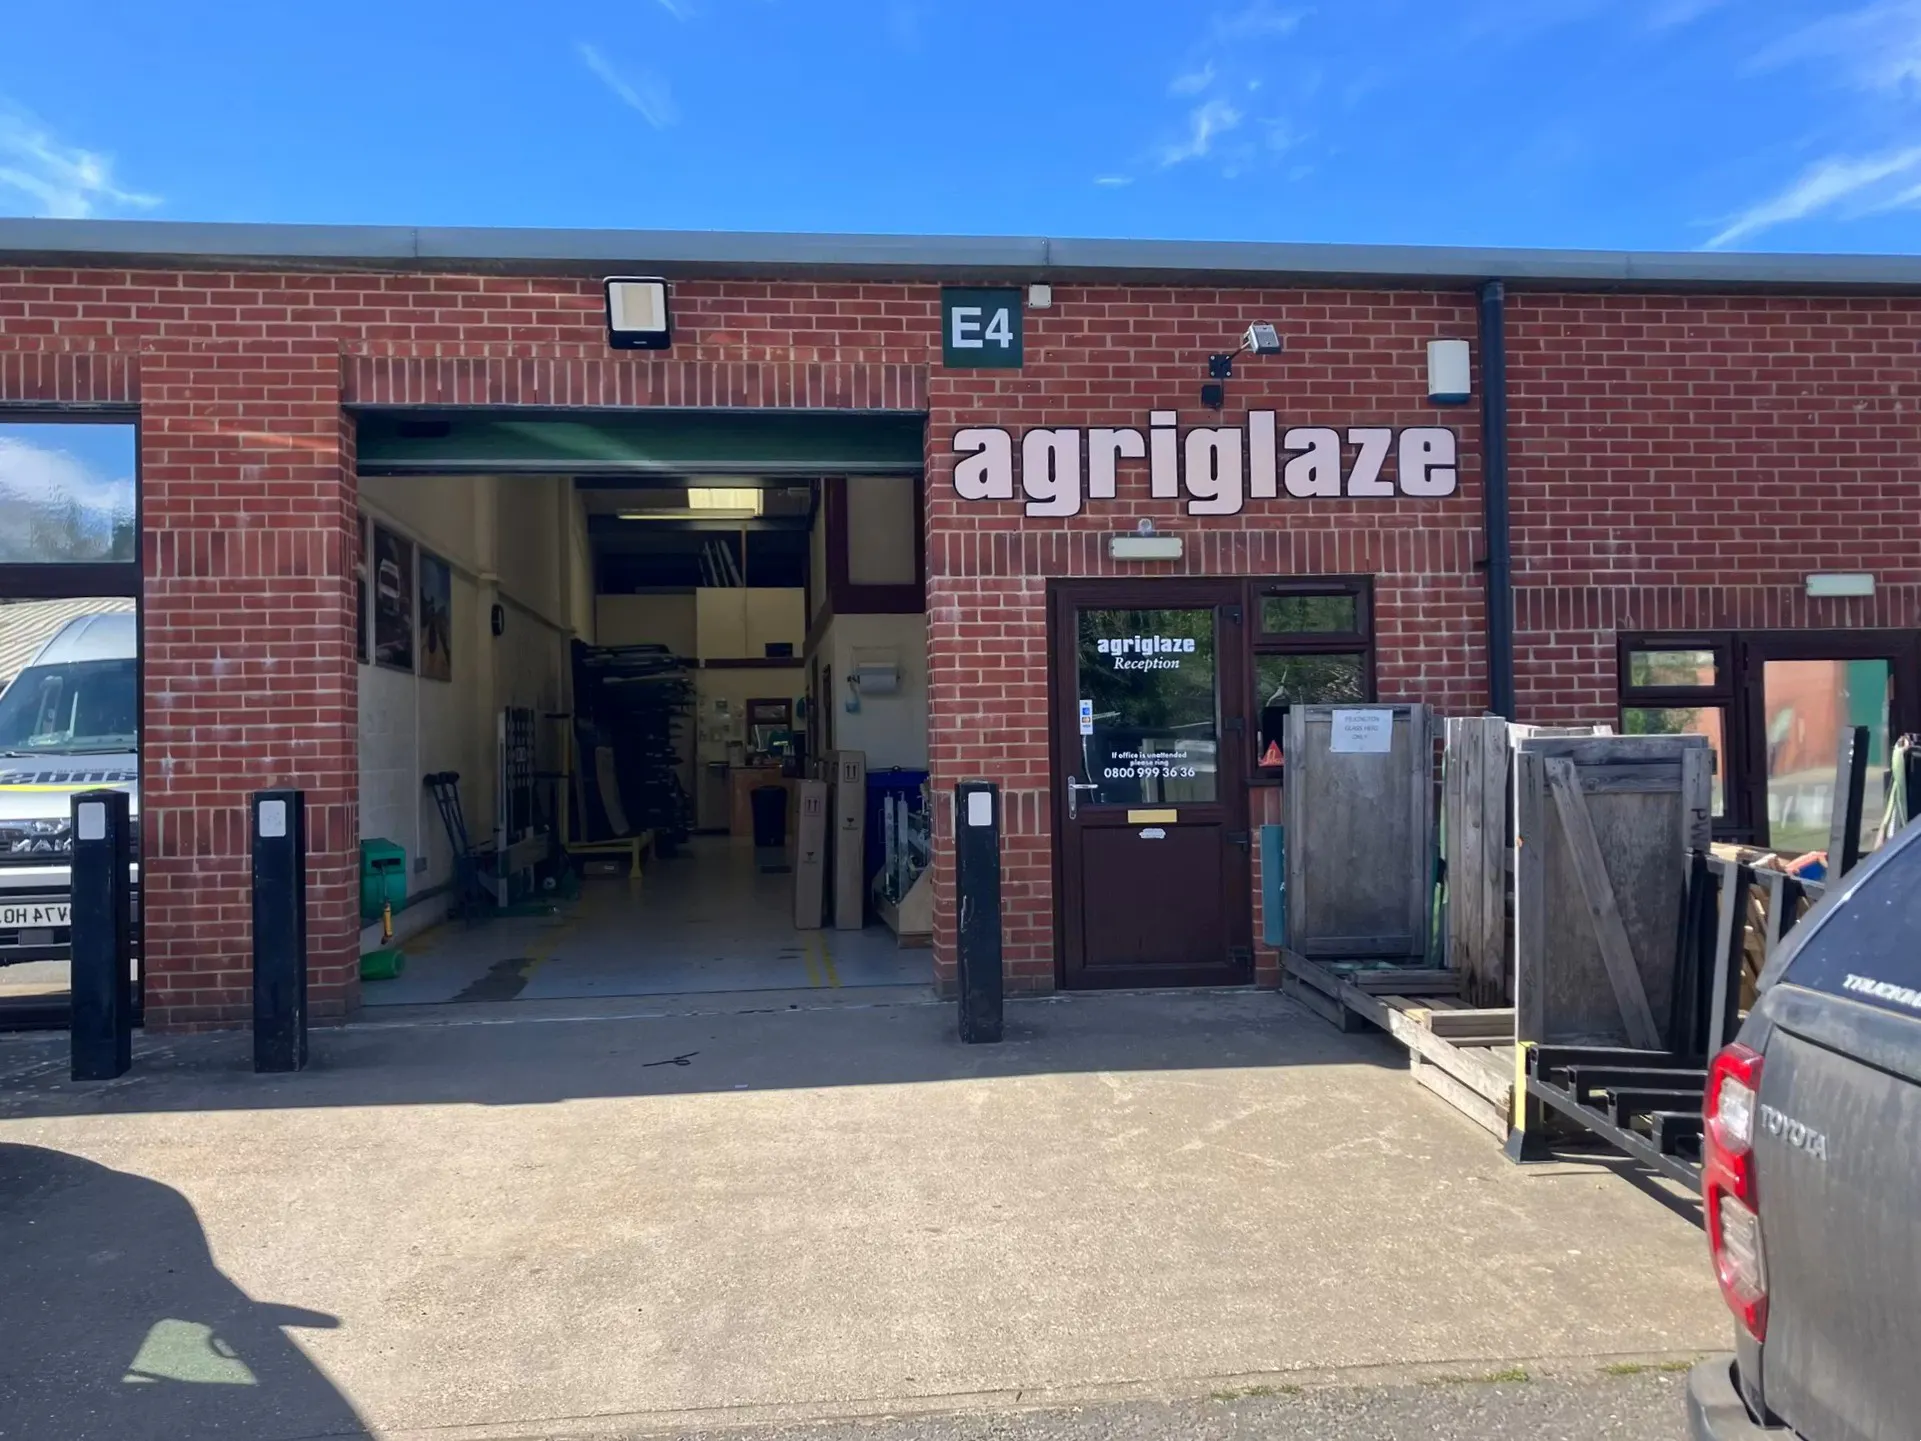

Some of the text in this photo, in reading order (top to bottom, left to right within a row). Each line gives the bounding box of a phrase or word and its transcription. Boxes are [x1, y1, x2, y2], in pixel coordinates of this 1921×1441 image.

[951, 306, 1014, 349] E4
[952, 409, 1458, 518] agriglaze
[1097, 635, 1195, 656] agriglaze
[1113, 656, 1180, 672] Reception
[1104, 767, 1196, 778] 0800 999 36 36
[1130, 759, 1170, 767] please ring
[1760, 1103, 1828, 1161] TOYOTA
